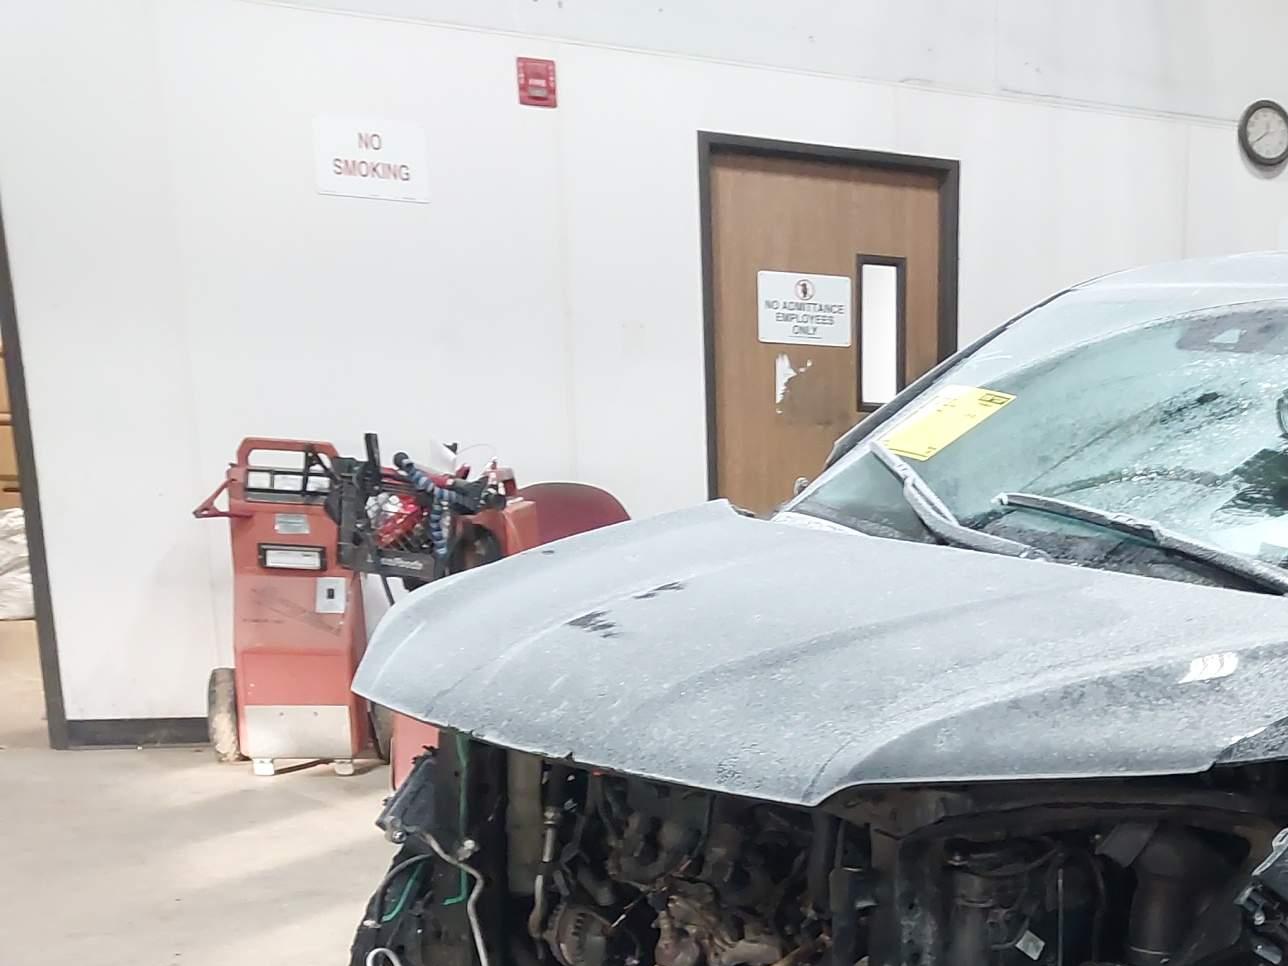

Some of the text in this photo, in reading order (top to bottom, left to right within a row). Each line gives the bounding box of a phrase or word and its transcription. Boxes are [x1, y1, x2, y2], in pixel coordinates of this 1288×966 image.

[357, 132, 382, 151] NO
[332, 157, 410, 181] SMOKING
[764, 300, 845, 315] NO ADMITTANCE
[775, 312, 835, 326] EMPLOYEES
[791, 324, 818, 336] ONLY
